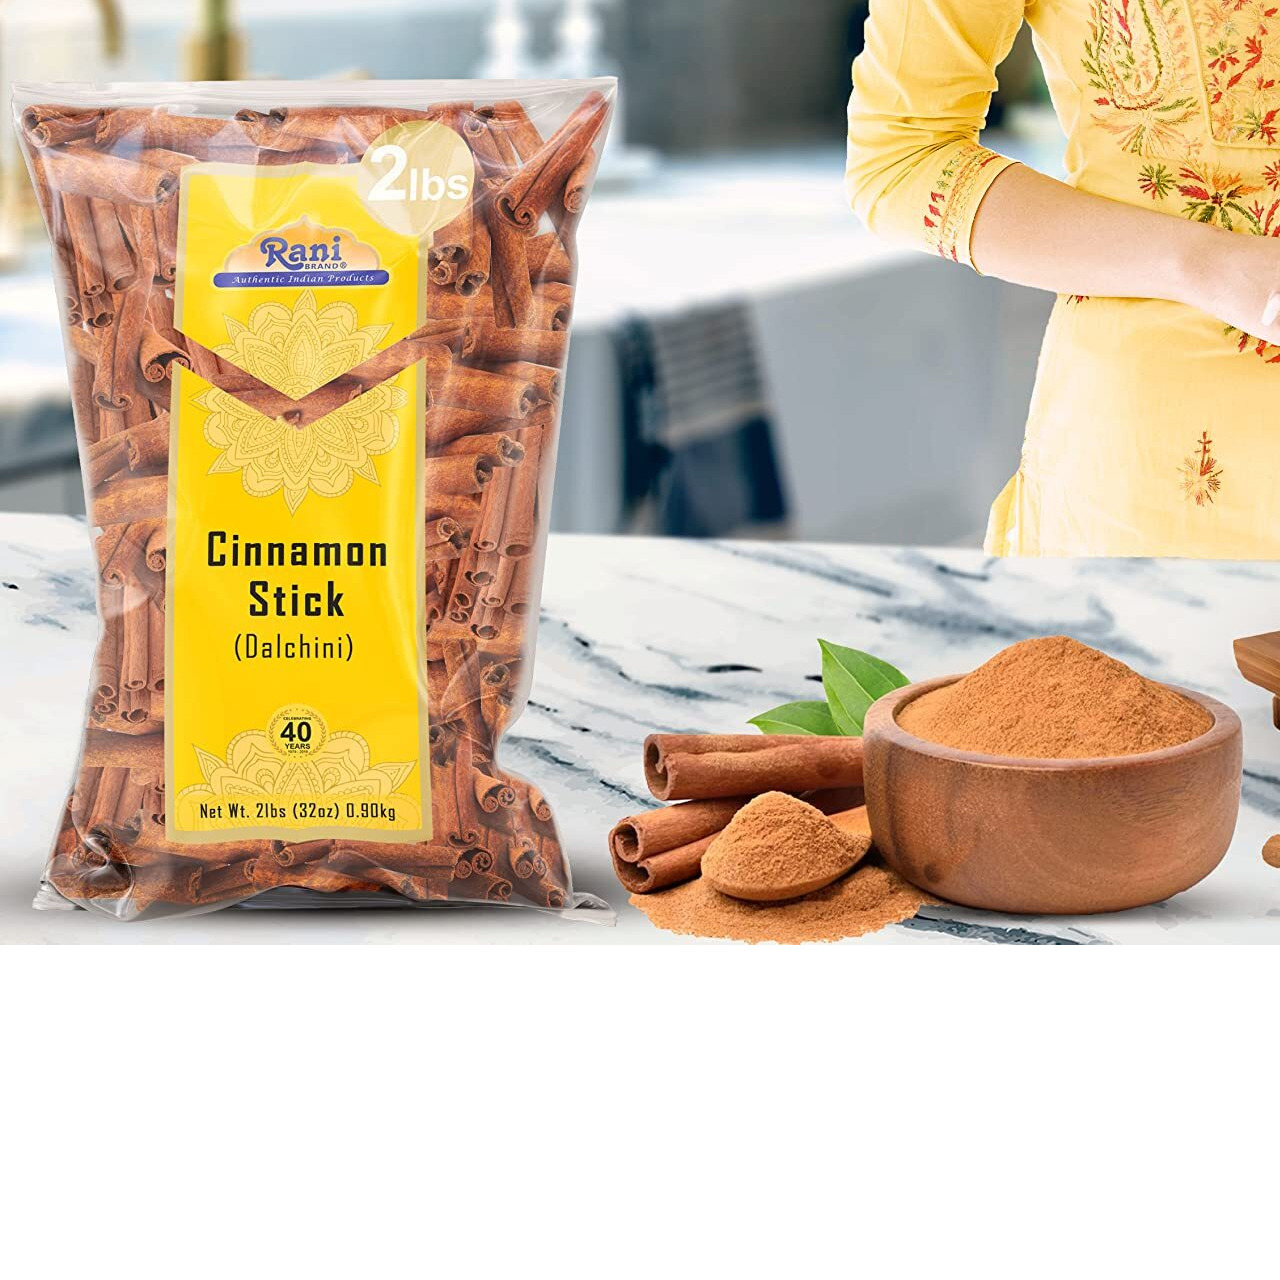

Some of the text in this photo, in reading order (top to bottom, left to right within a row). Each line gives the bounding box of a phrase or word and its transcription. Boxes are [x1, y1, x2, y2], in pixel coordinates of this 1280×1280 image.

[368, 145, 468, 200] 2lbs
[260, 236, 342, 271] Rani
[231, 273, 375, 284] Authentic Indian Products
[208, 531, 387, 567] Cinnamon
[249, 581, 345, 617] Stick
[234, 633, 353, 662] (Dalchini)
[280, 721, 312, 742] 40
[200, 802, 396, 821] Net Wt. 2lbs (32oz) 0.90kg
